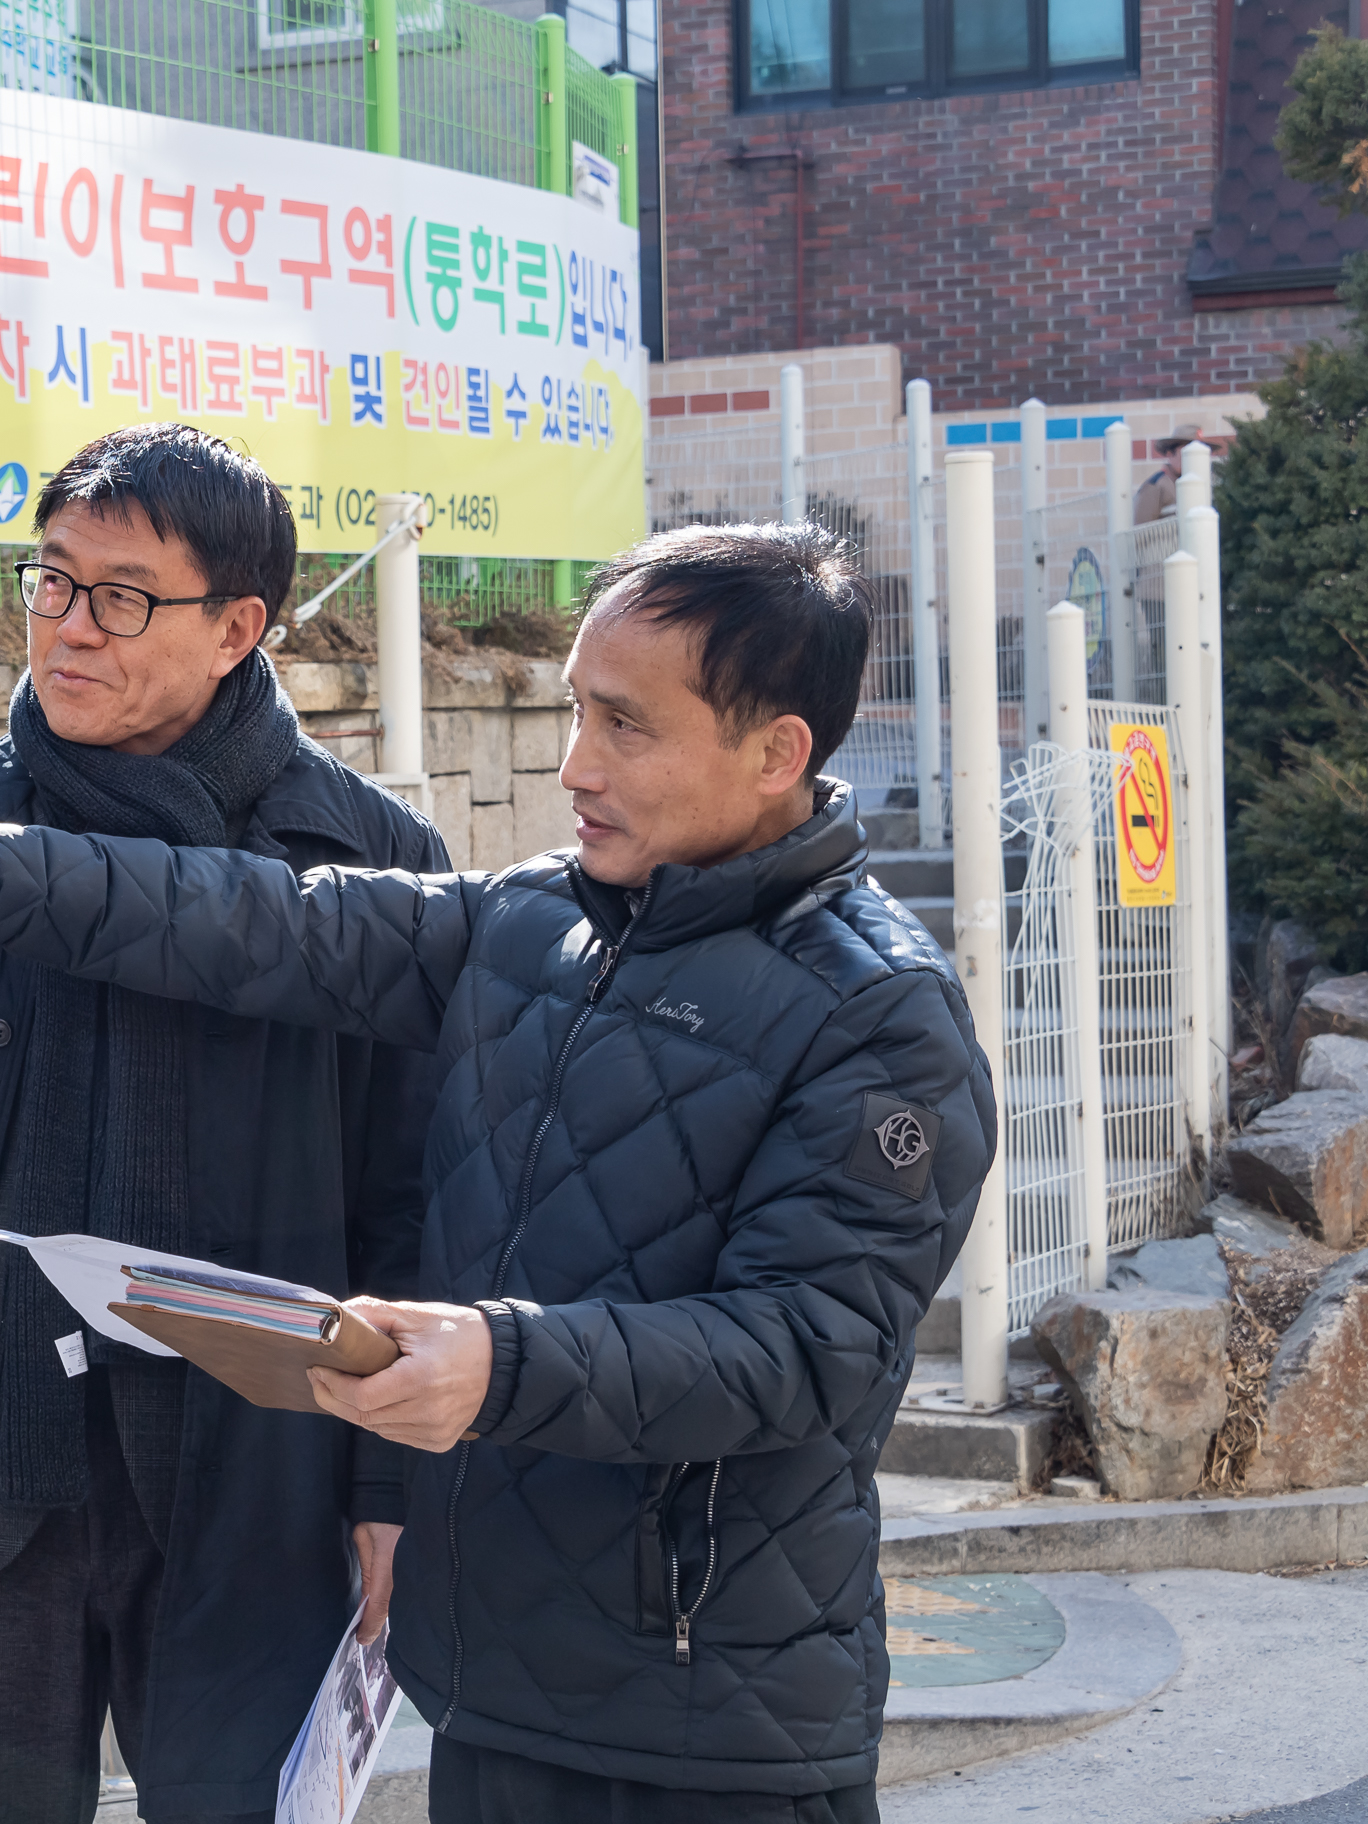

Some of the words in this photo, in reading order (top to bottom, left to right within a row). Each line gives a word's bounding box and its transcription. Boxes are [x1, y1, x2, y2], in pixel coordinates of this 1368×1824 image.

[48, 324, 90, 403] 시
[110, 330, 331, 421] 과태료부과
[350, 353, 383, 424] 및
[403, 358, 491, 435] 견인될
[505, 372, 527, 438] 수
[541, 375, 614, 451] 있습니다.
